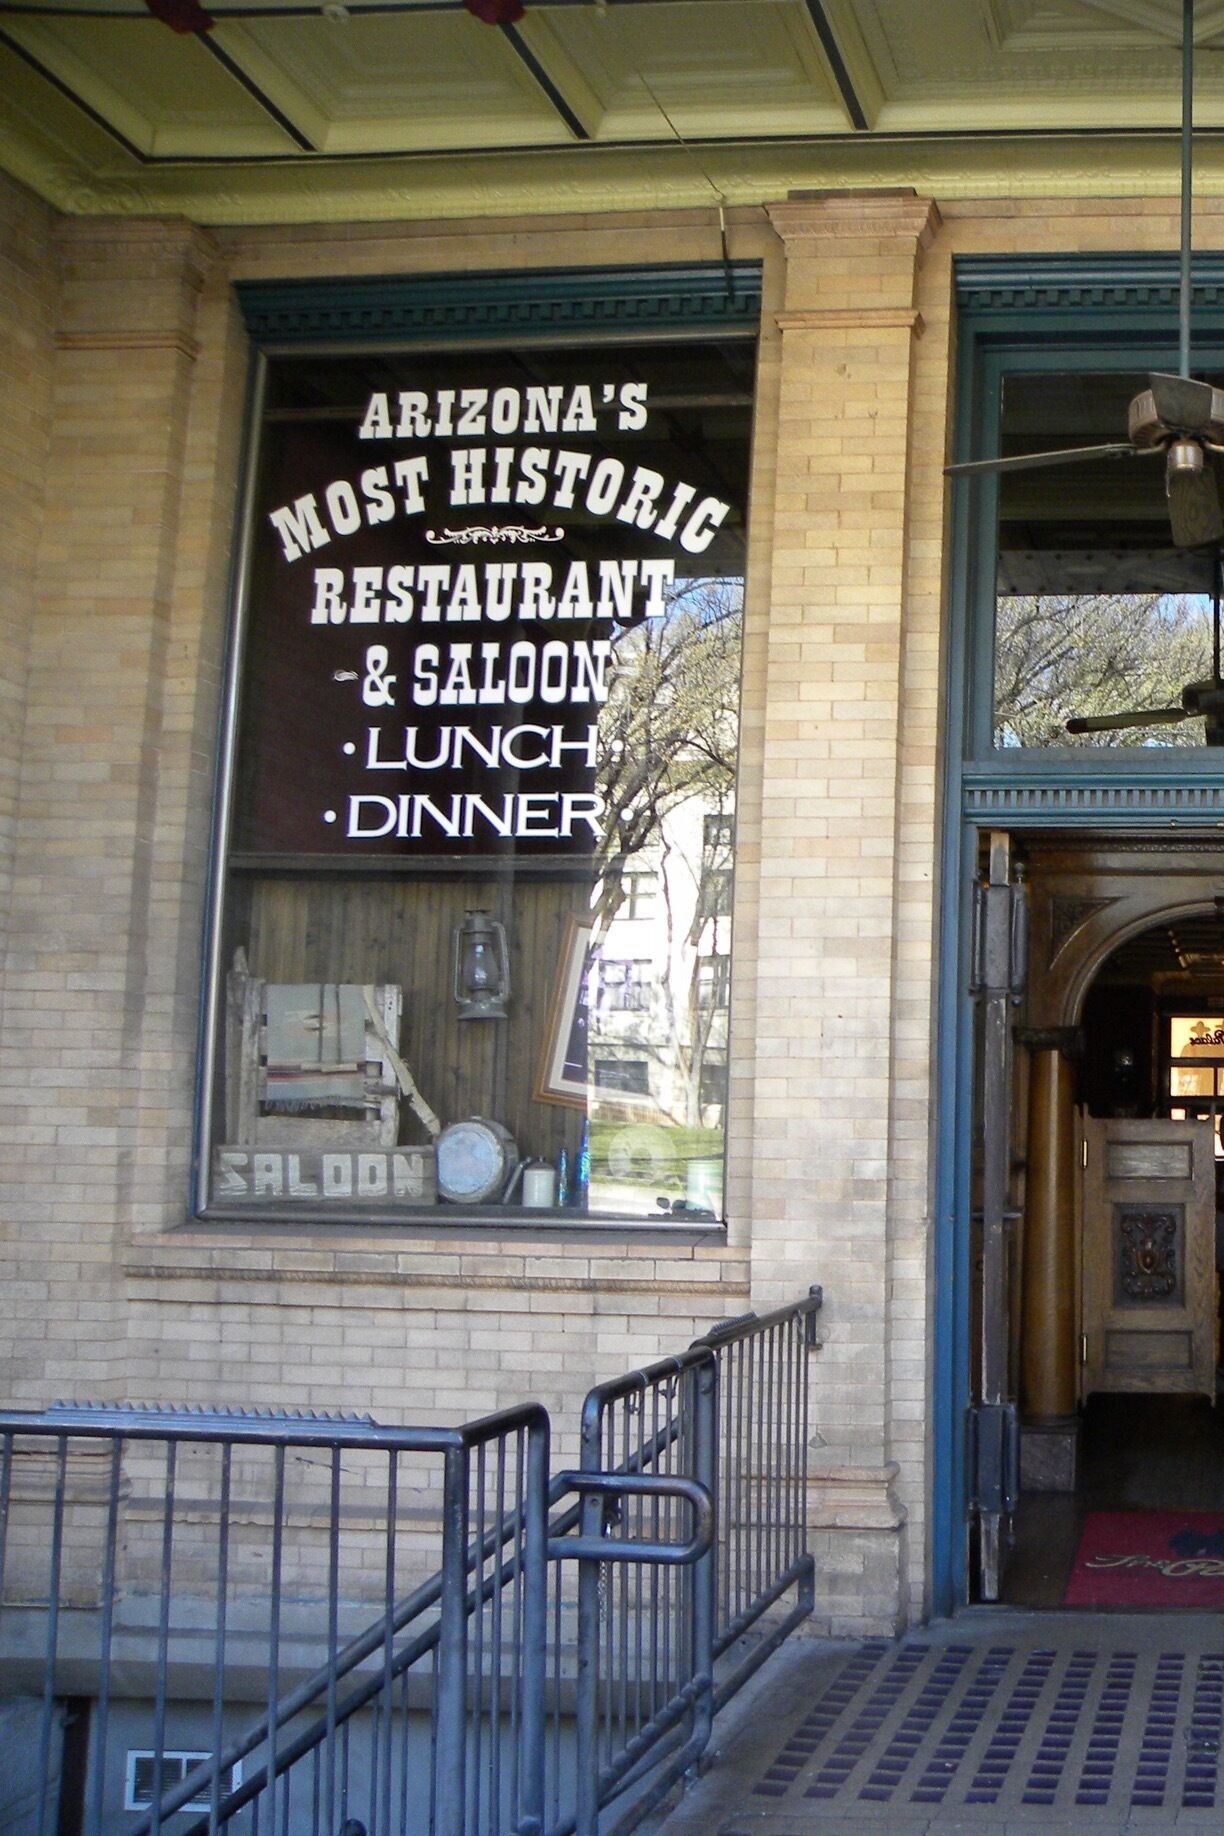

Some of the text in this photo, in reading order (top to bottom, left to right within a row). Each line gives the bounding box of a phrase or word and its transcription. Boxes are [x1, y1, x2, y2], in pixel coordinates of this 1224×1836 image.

[358, 382, 649, 440] ARIZONA'S
[268, 446, 731, 563] MOST HISTORIC
[310, 559, 676, 626] RESTAURANT
[361, 639, 612, 708] & SALOON
[365, 723, 600, 770] LUNCH
[346, 792, 608, 839] DINNER
[216, 1151, 424, 1198] SALOON
